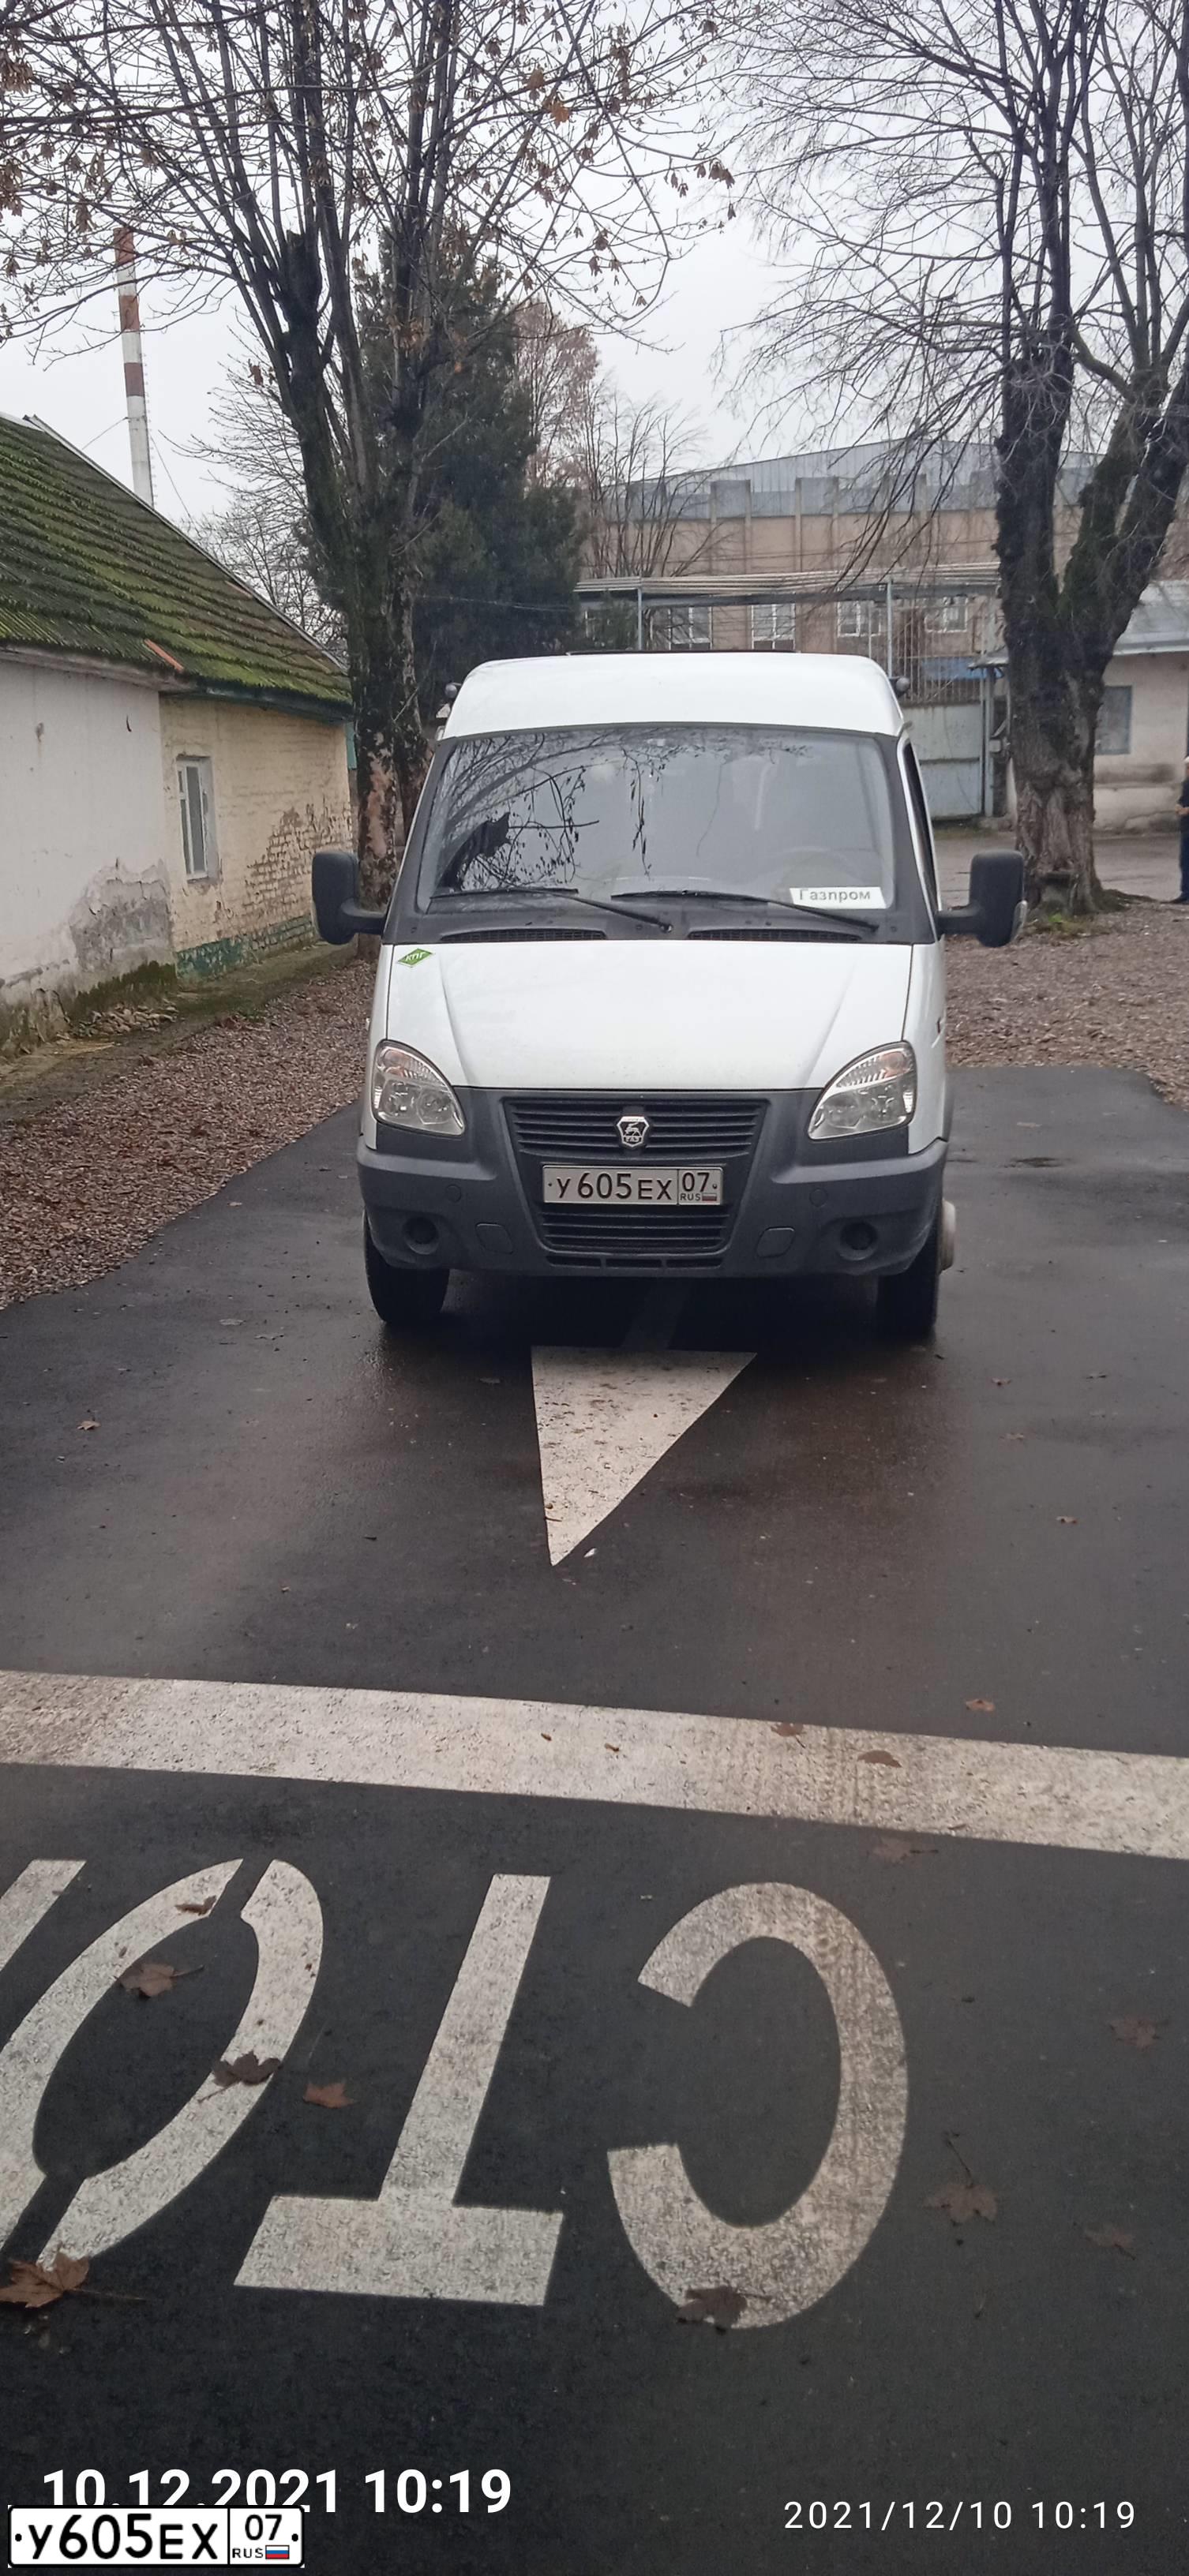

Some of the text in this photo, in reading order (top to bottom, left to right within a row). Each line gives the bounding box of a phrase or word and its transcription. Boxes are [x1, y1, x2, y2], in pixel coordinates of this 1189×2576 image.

[799, 889, 871, 904] Газпром
[681, 1172, 710, 1193] 07
[680, 1193, 701, 1201] RUS
[0, 1858, 908, 2328] СТО
